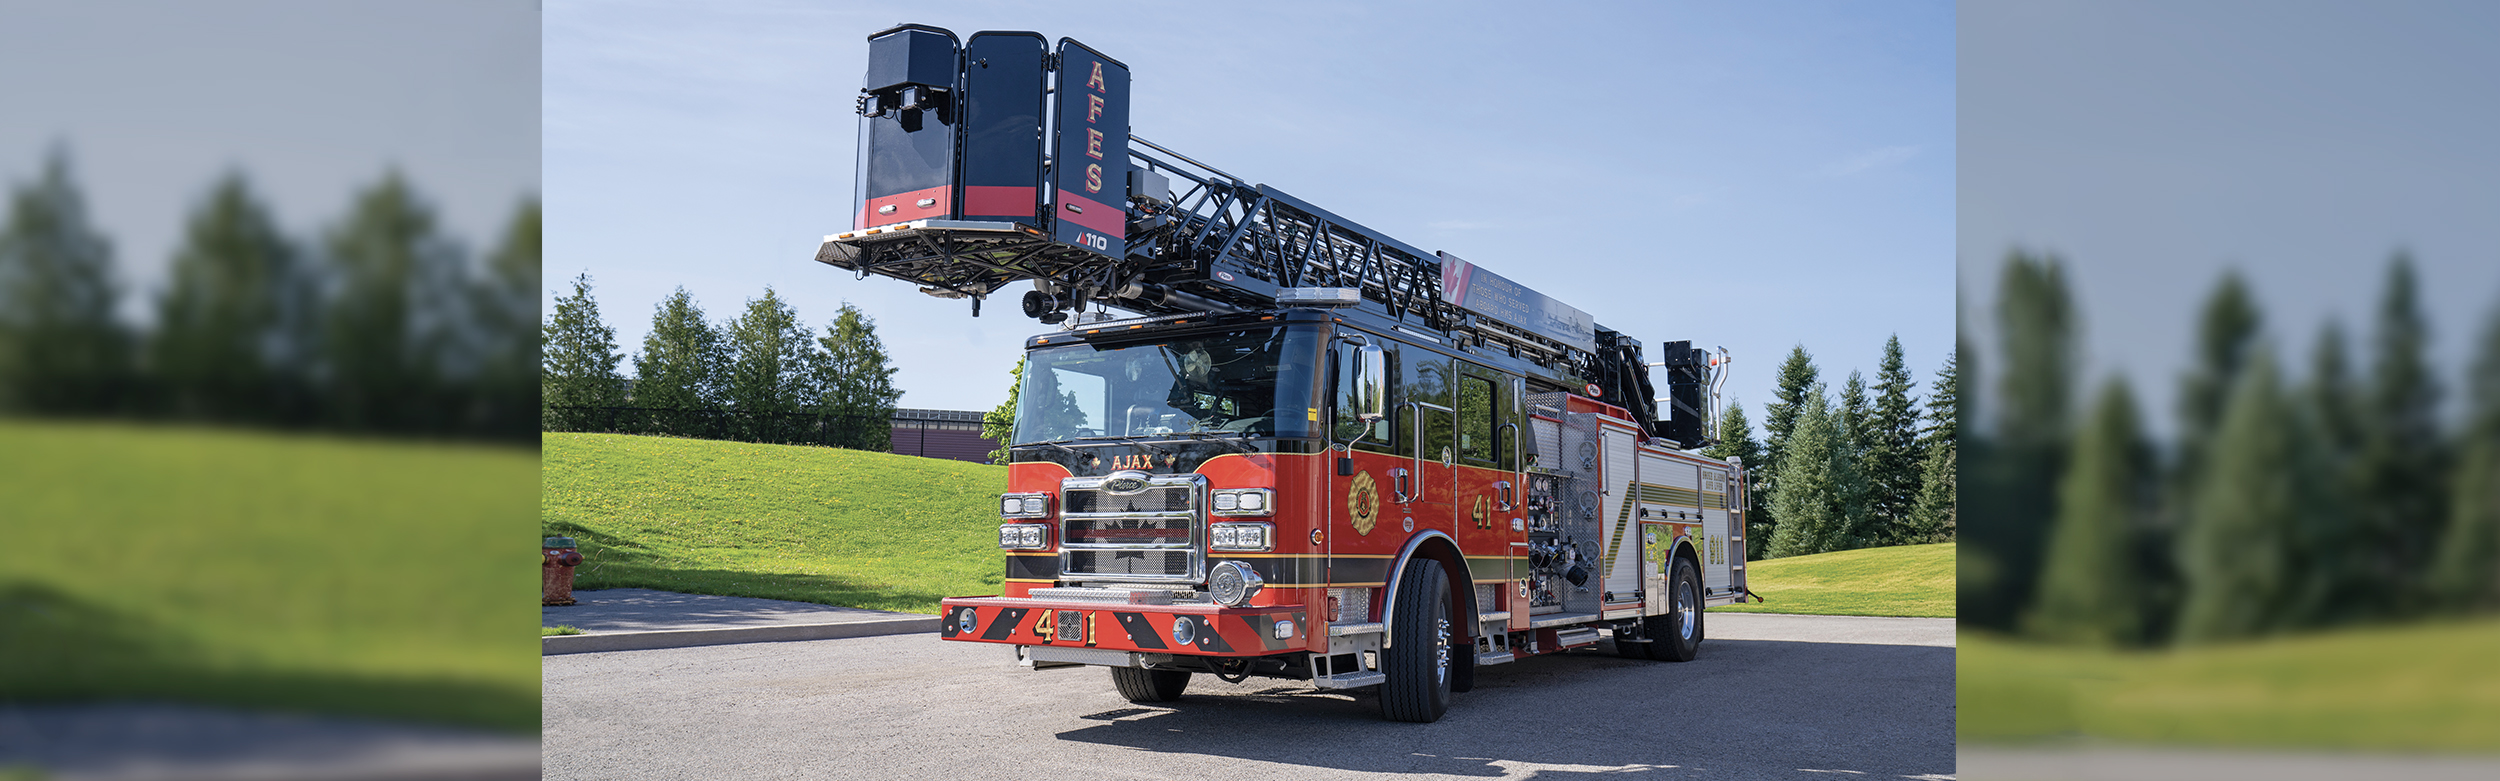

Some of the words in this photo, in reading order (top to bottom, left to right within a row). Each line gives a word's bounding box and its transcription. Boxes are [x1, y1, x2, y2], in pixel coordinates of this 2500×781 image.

[1086, 60, 1106, 194] AFES
[1472, 283, 1492, 299] THOSE
[1494, 291, 1507, 305] WHO
[1508, 297, 1530, 314] SERVED
[1490, 276, 1512, 295] HONOUR
[1514, 287, 1522, 298] OF
[1475, 299, 1498, 315] ABOARD
[1500, 308, 1513, 321] HMS
[1514, 313, 1528, 326] AJAX
[1111, 454, 1153, 470] AJAX
[1471, 494, 1491, 530] 41
